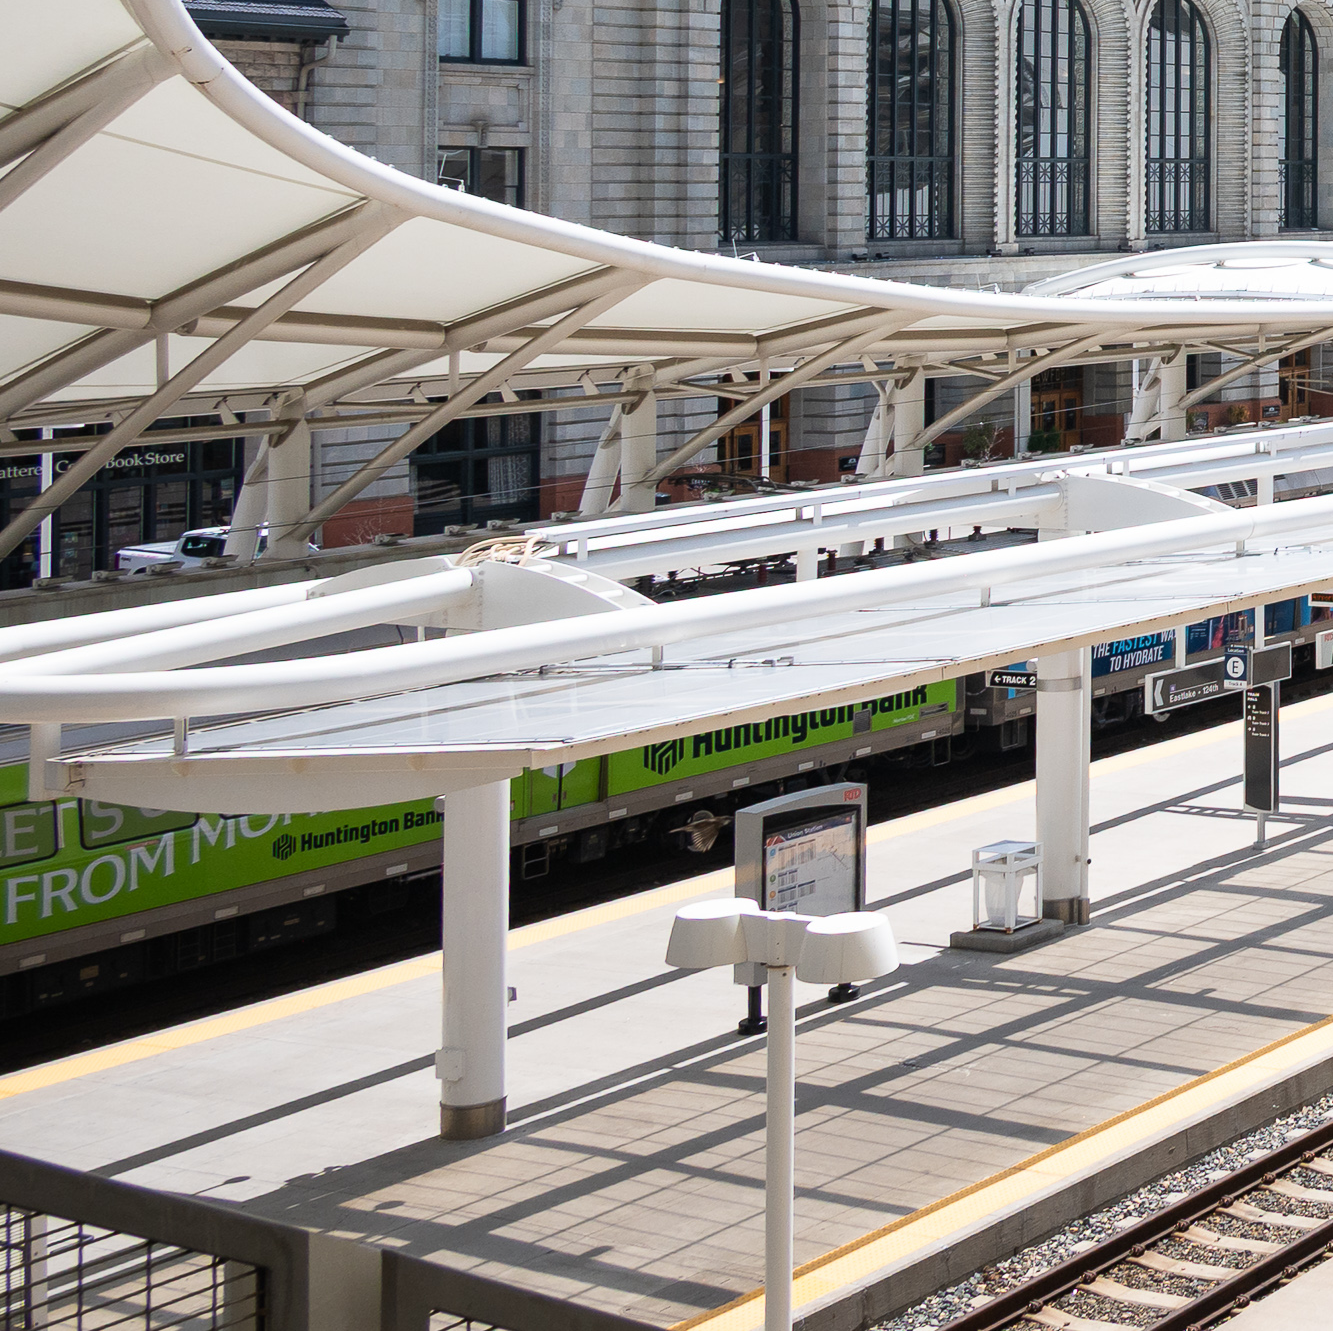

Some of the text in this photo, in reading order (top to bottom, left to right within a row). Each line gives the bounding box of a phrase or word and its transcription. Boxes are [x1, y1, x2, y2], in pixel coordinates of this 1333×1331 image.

[145, 452, 185, 466] Store
[1093, 628, 1177, 659] THE FASTEST WA
[1110, 645, 1165, 673] TO HYDRATE
[1232, 660, 1239, 674] E
[1002, 675, 1036, 686] TRACK 2
[1169, 683, 1219, 703] Eastlake 124th
[843, 787, 862, 802] RTD
[301, 817, 400, 853] Huntington
[787, 824, 823, 839] Union Station
[5, 832, 176, 925] FROM
